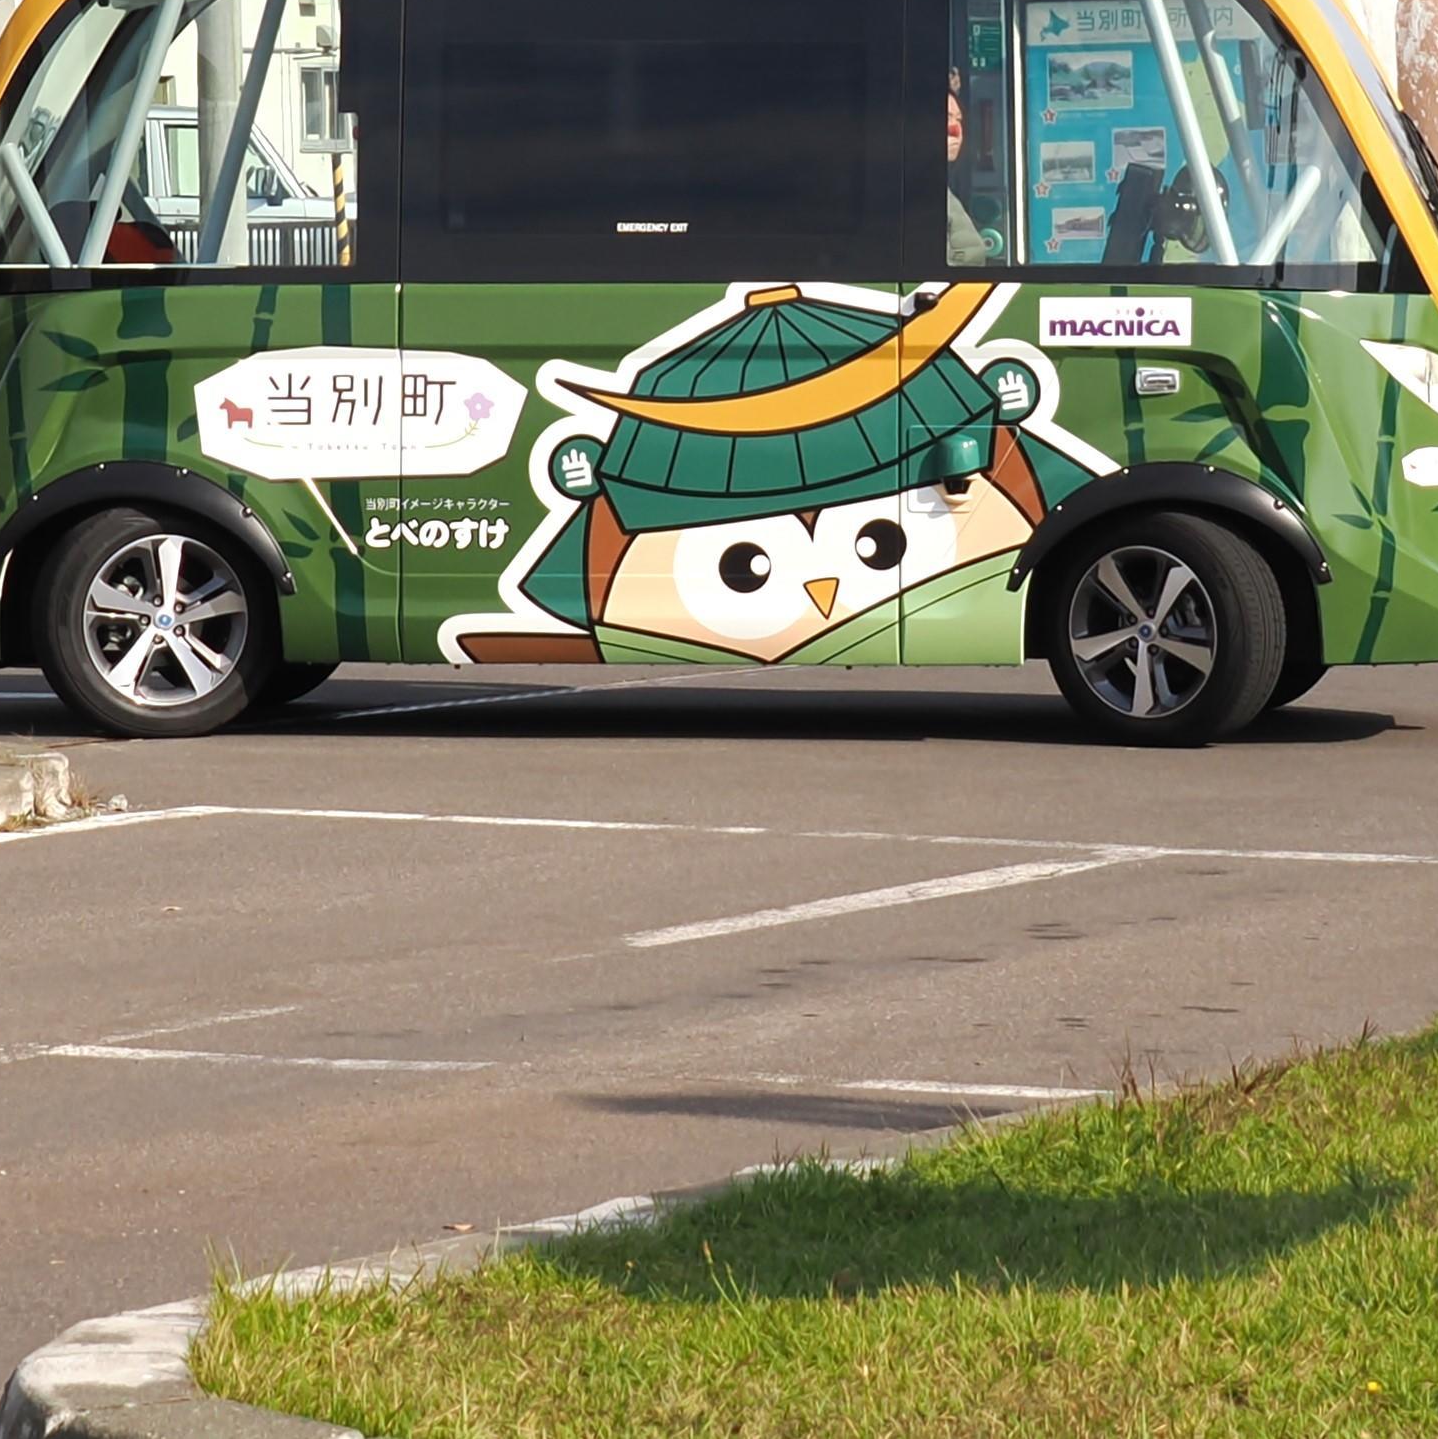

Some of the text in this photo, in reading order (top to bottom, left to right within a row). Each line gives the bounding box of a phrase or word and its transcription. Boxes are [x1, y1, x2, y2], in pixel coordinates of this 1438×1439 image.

[1076, 7, 1233, 31] 当別町所内
[617, 222, 689, 232] EMERGENCY EXIT
[267, 373, 457, 426] 当別町
[365, 497, 510, 511] 当別町イメージキャラクター
[364, 516, 510, 550] とべのすけ
